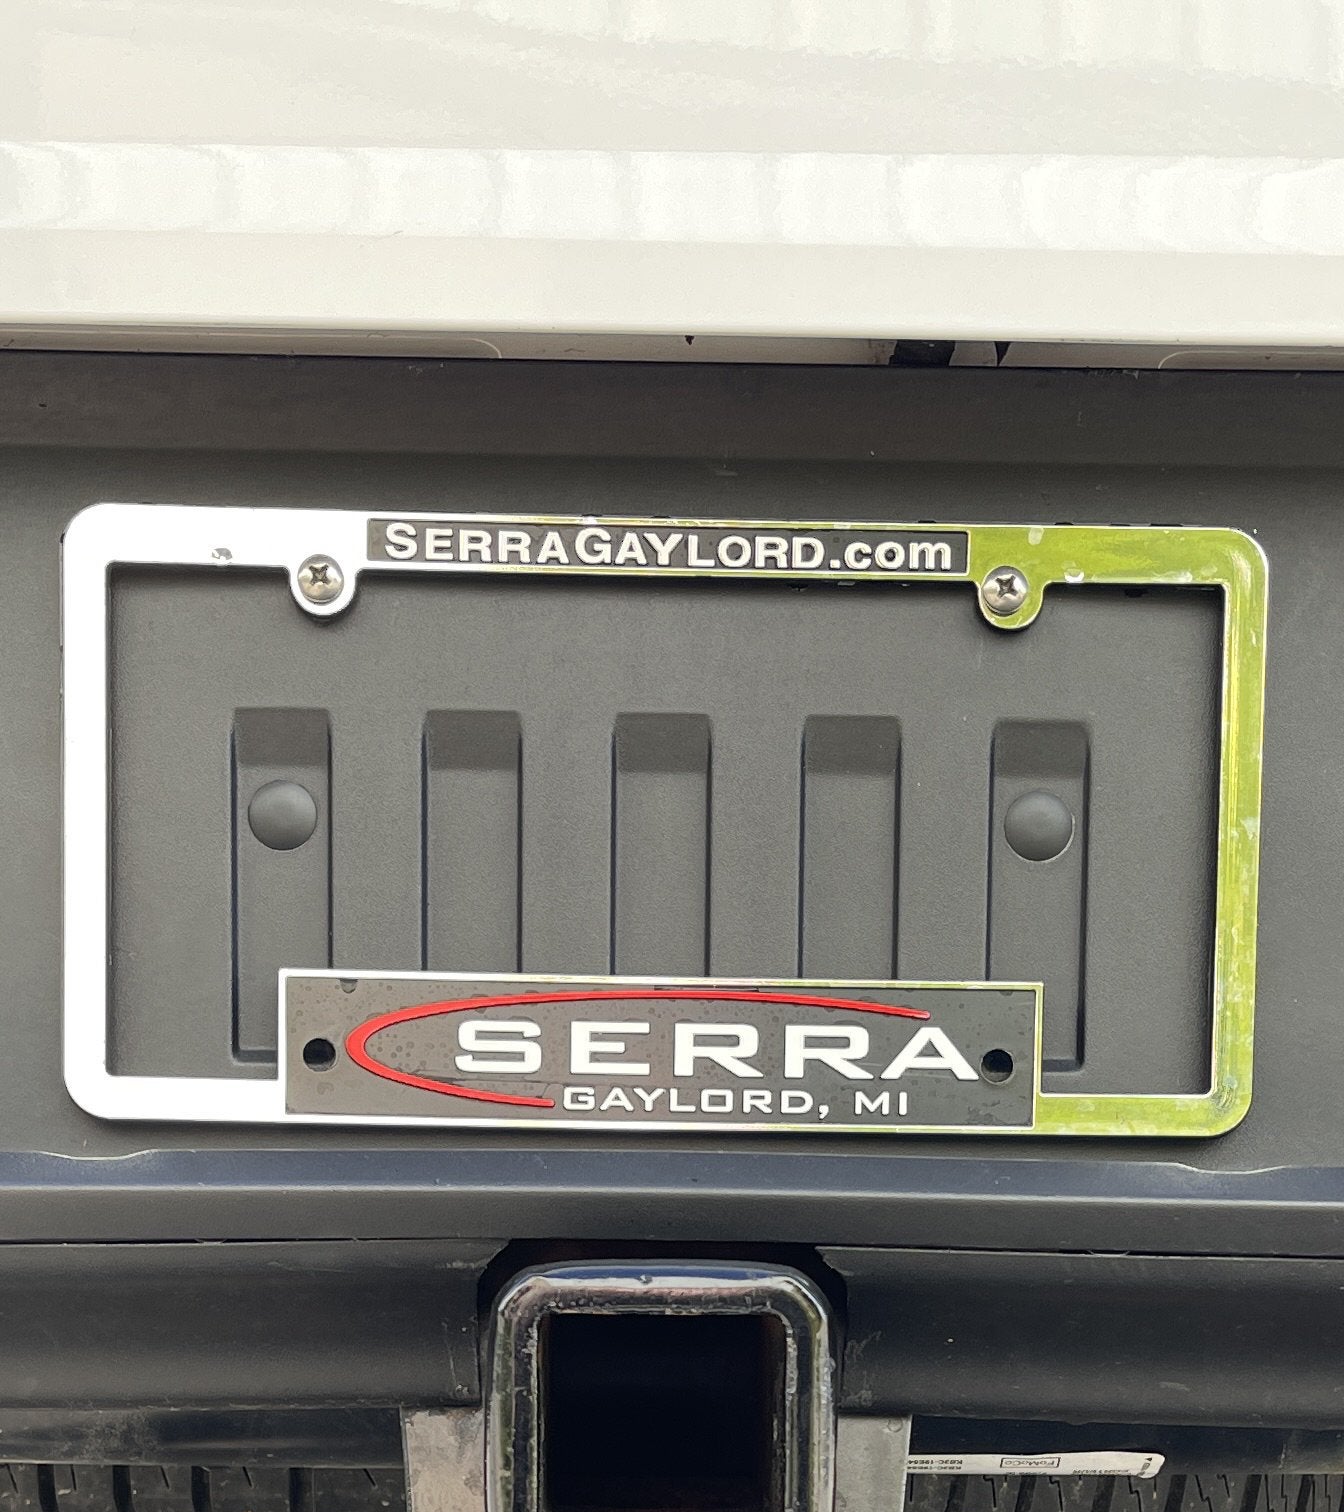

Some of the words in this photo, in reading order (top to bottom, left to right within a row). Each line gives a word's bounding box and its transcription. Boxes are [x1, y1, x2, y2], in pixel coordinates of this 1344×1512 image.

[383, 522, 953, 571] SERRAGAYLORD.com
[455, 1019, 980, 1082] SERRA
[563, 1087, 829, 1120] GAYLORD,
[855, 1091, 908, 1116] MI
[1004, 1458, 1056, 1468] FoMoCo
